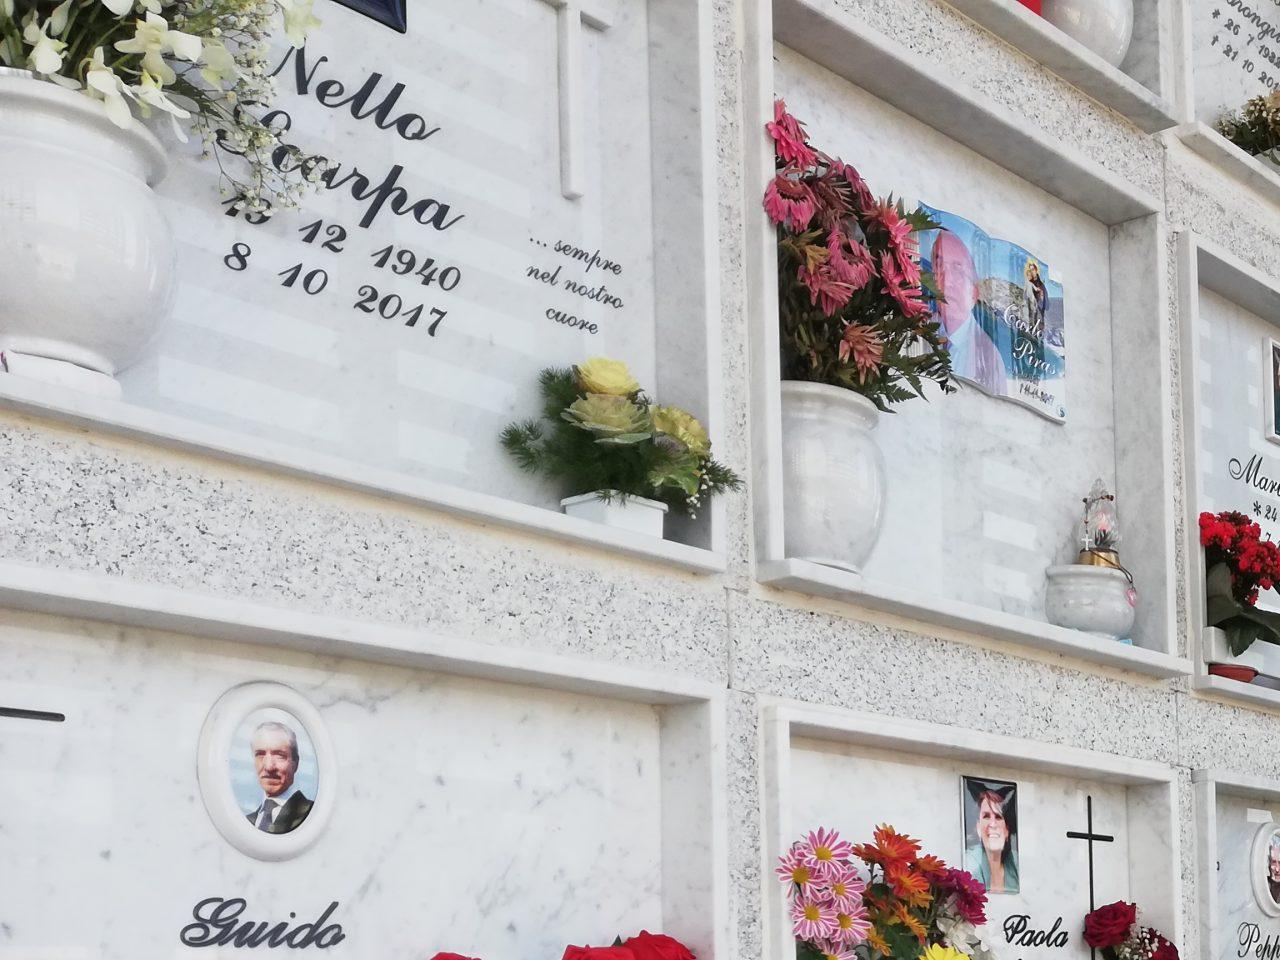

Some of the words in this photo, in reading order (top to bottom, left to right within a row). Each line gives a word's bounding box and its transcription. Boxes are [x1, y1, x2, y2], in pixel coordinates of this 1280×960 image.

[1224, 18, 1241, 36] 26
[1222, 44, 1239, 61] 21
[1242, 59, 1255, 73] 10
[1258, 71, 1280, 90] 201
[267, 40, 441, 141] Nello
[216, 100, 465, 229] Scarpa
[298, 219, 347, 253] 12
[371, 245, 462, 292] 1940
[223, 242, 252, 271] 8
[278, 263, 329, 295] 10
[354, 285, 448, 337] 2017
[527, 265, 562, 286] nel
[565, 285, 624, 309] nostro
[546, 308, 598, 334] cuore
[1004, 304, 1045, 340] Carlo
[1013, 337, 1056, 375] Piras
[1264, 504, 1278, 522] 24
[180, 897, 346, 949] Guido
[1003, 914, 1069, 948] Paola
